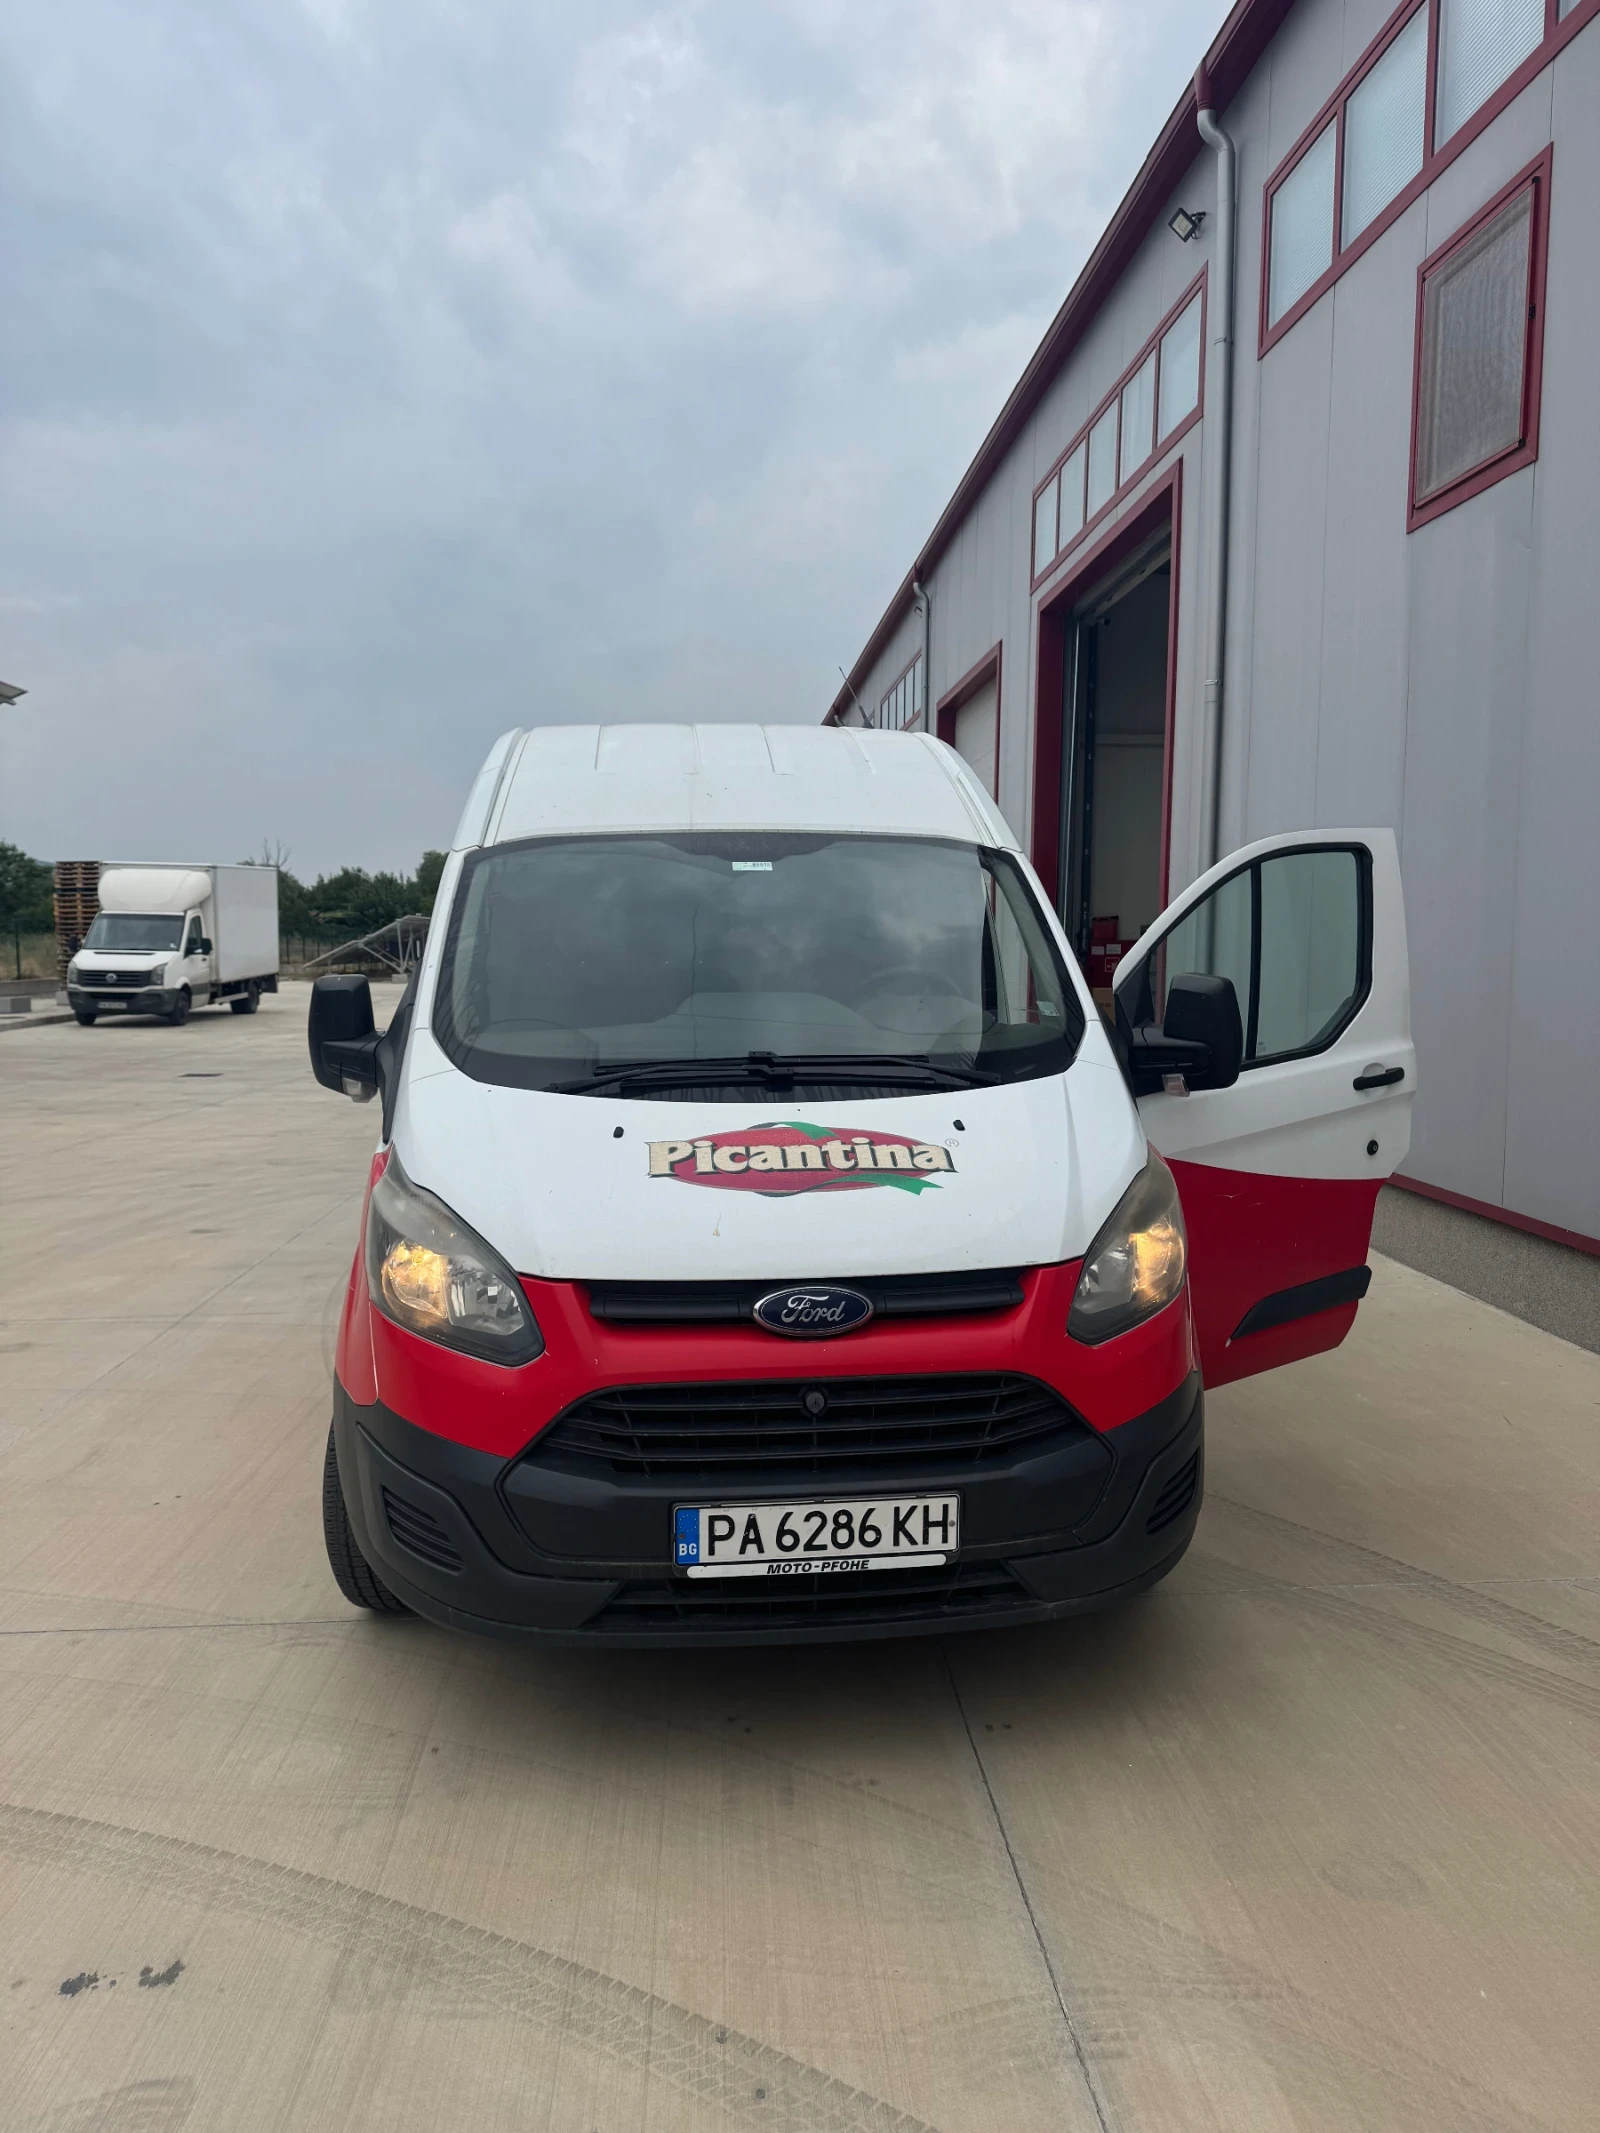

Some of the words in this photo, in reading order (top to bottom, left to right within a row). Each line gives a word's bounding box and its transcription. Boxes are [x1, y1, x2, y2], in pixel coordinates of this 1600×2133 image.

[645, 1137, 957, 1177] Picantina
[781, 1295, 846, 1323] Ford
[678, 1543, 698, 1556] BG
[766, 1559, 870, 1575] MOTO-PFOHE
